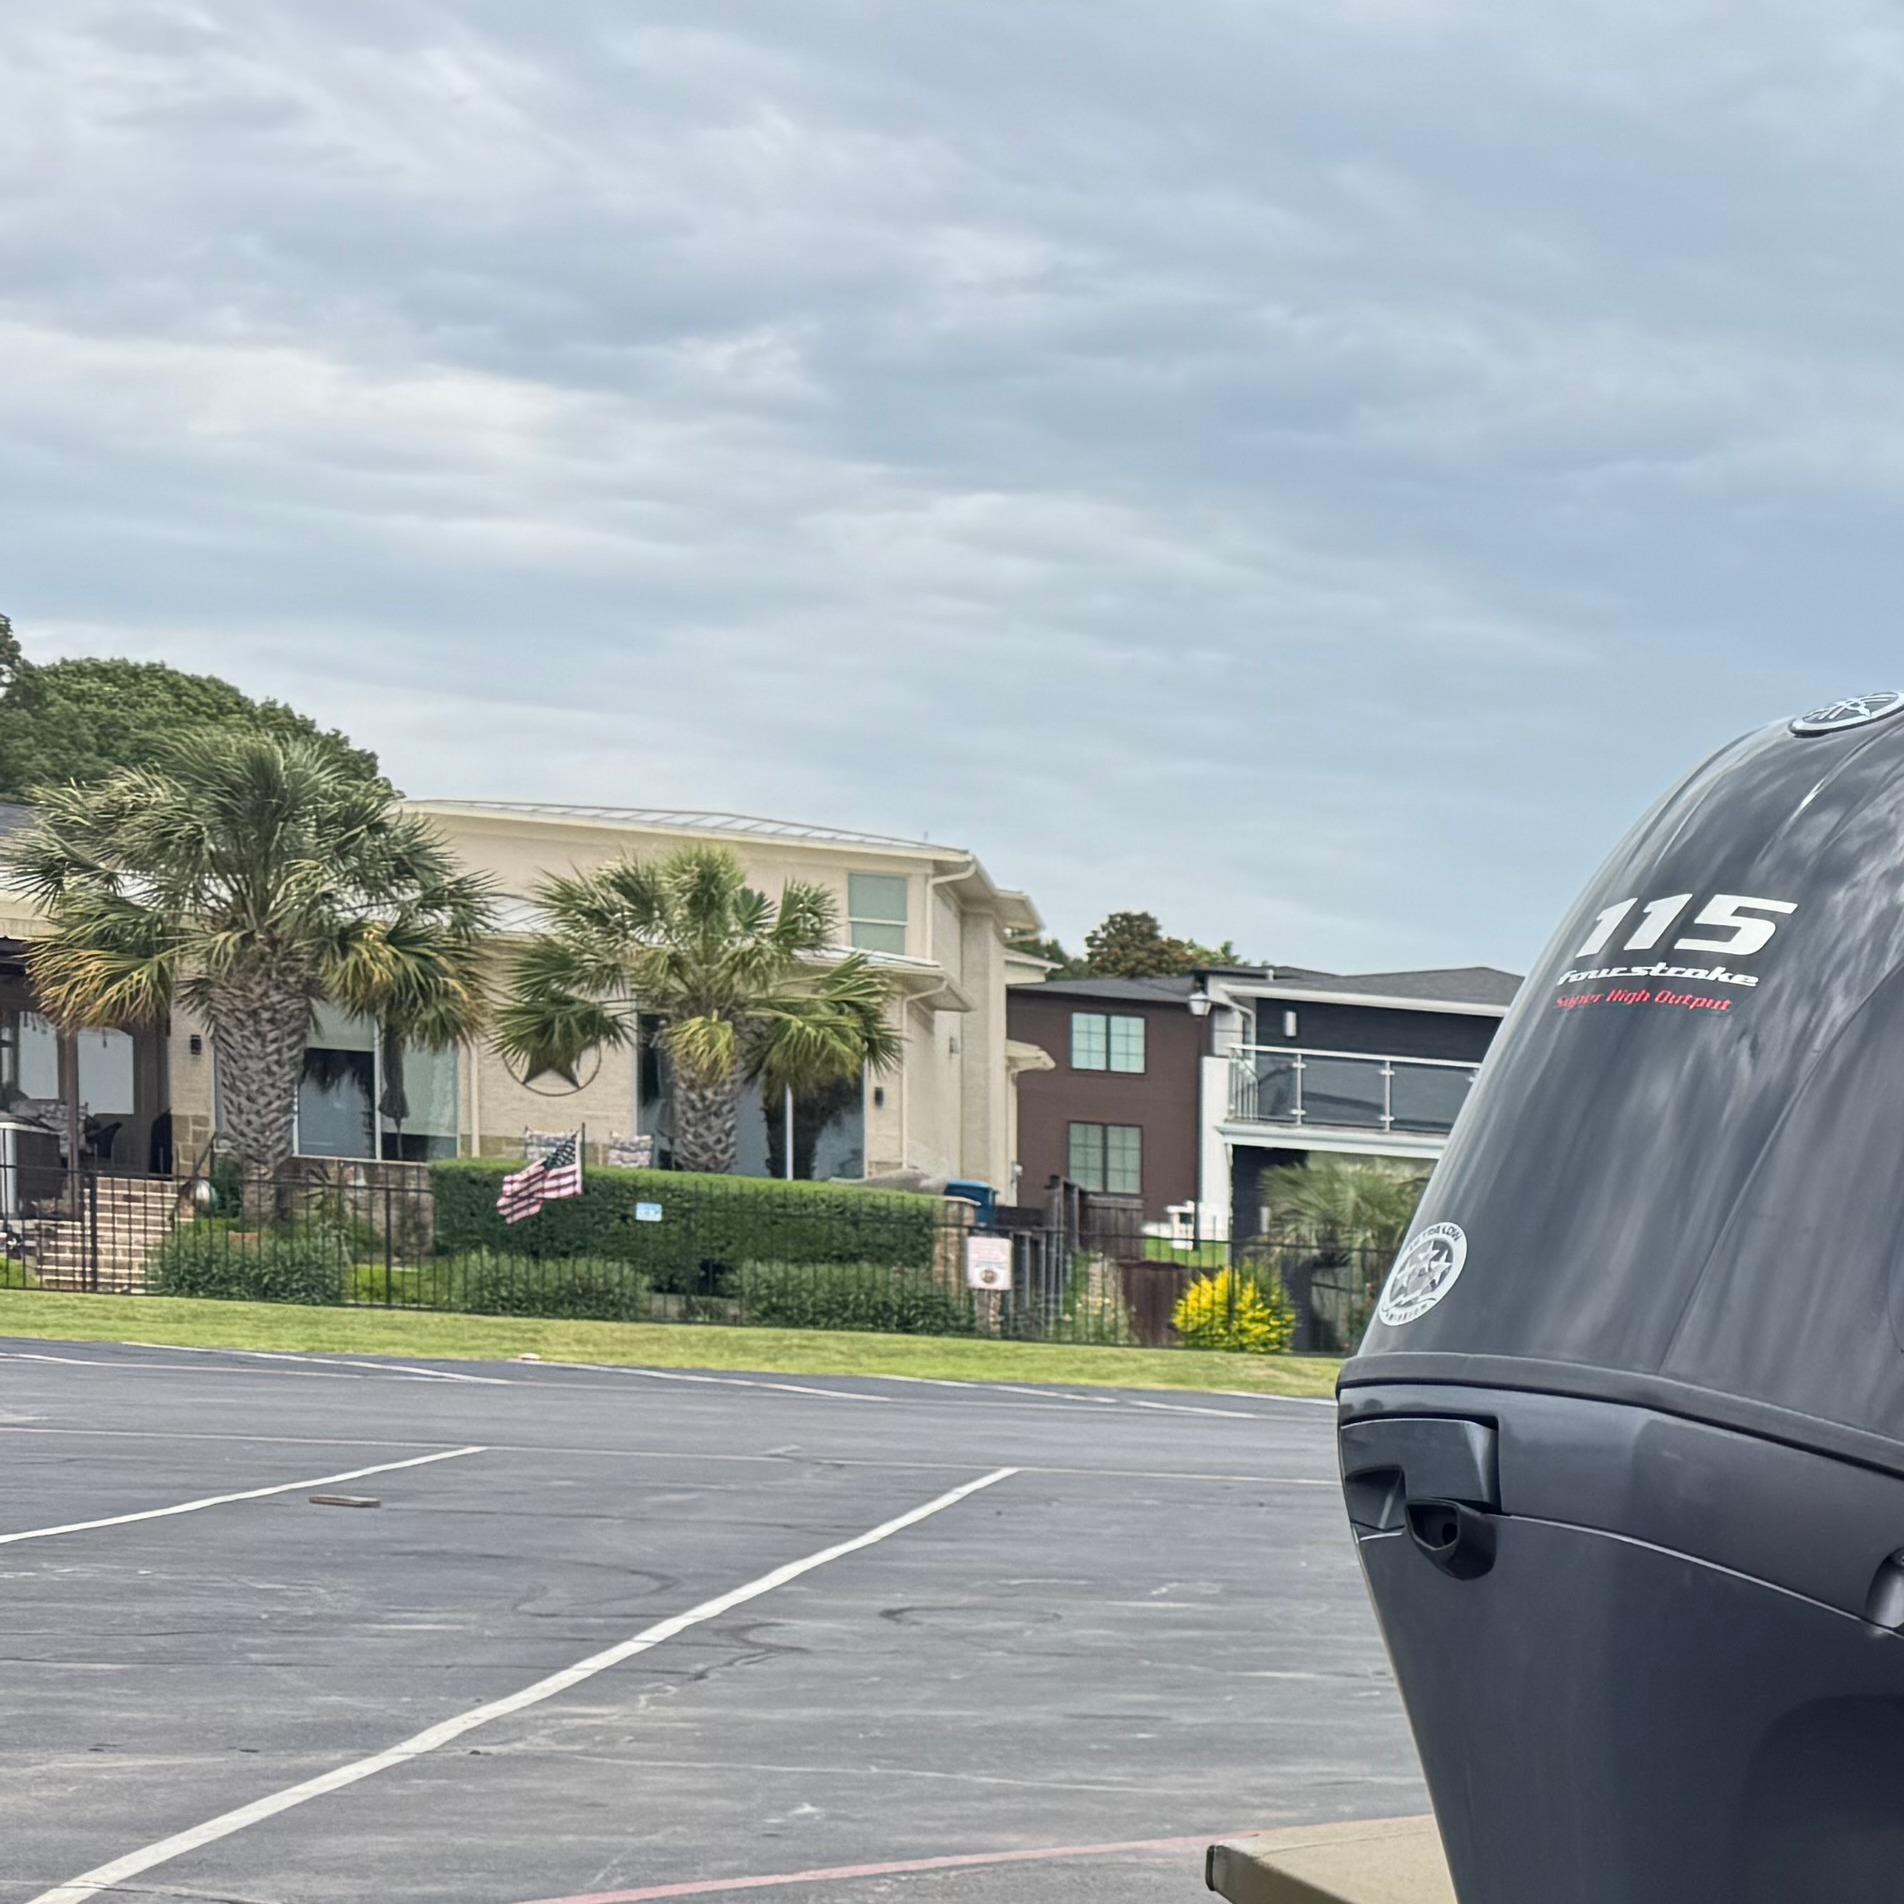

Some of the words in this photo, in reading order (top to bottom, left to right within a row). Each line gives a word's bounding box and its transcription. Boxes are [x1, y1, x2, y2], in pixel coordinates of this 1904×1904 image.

[1575, 893, 1799, 959] 115
[1605, 989, 1651, 1005] High
[1654, 990, 1734, 1013] Output
